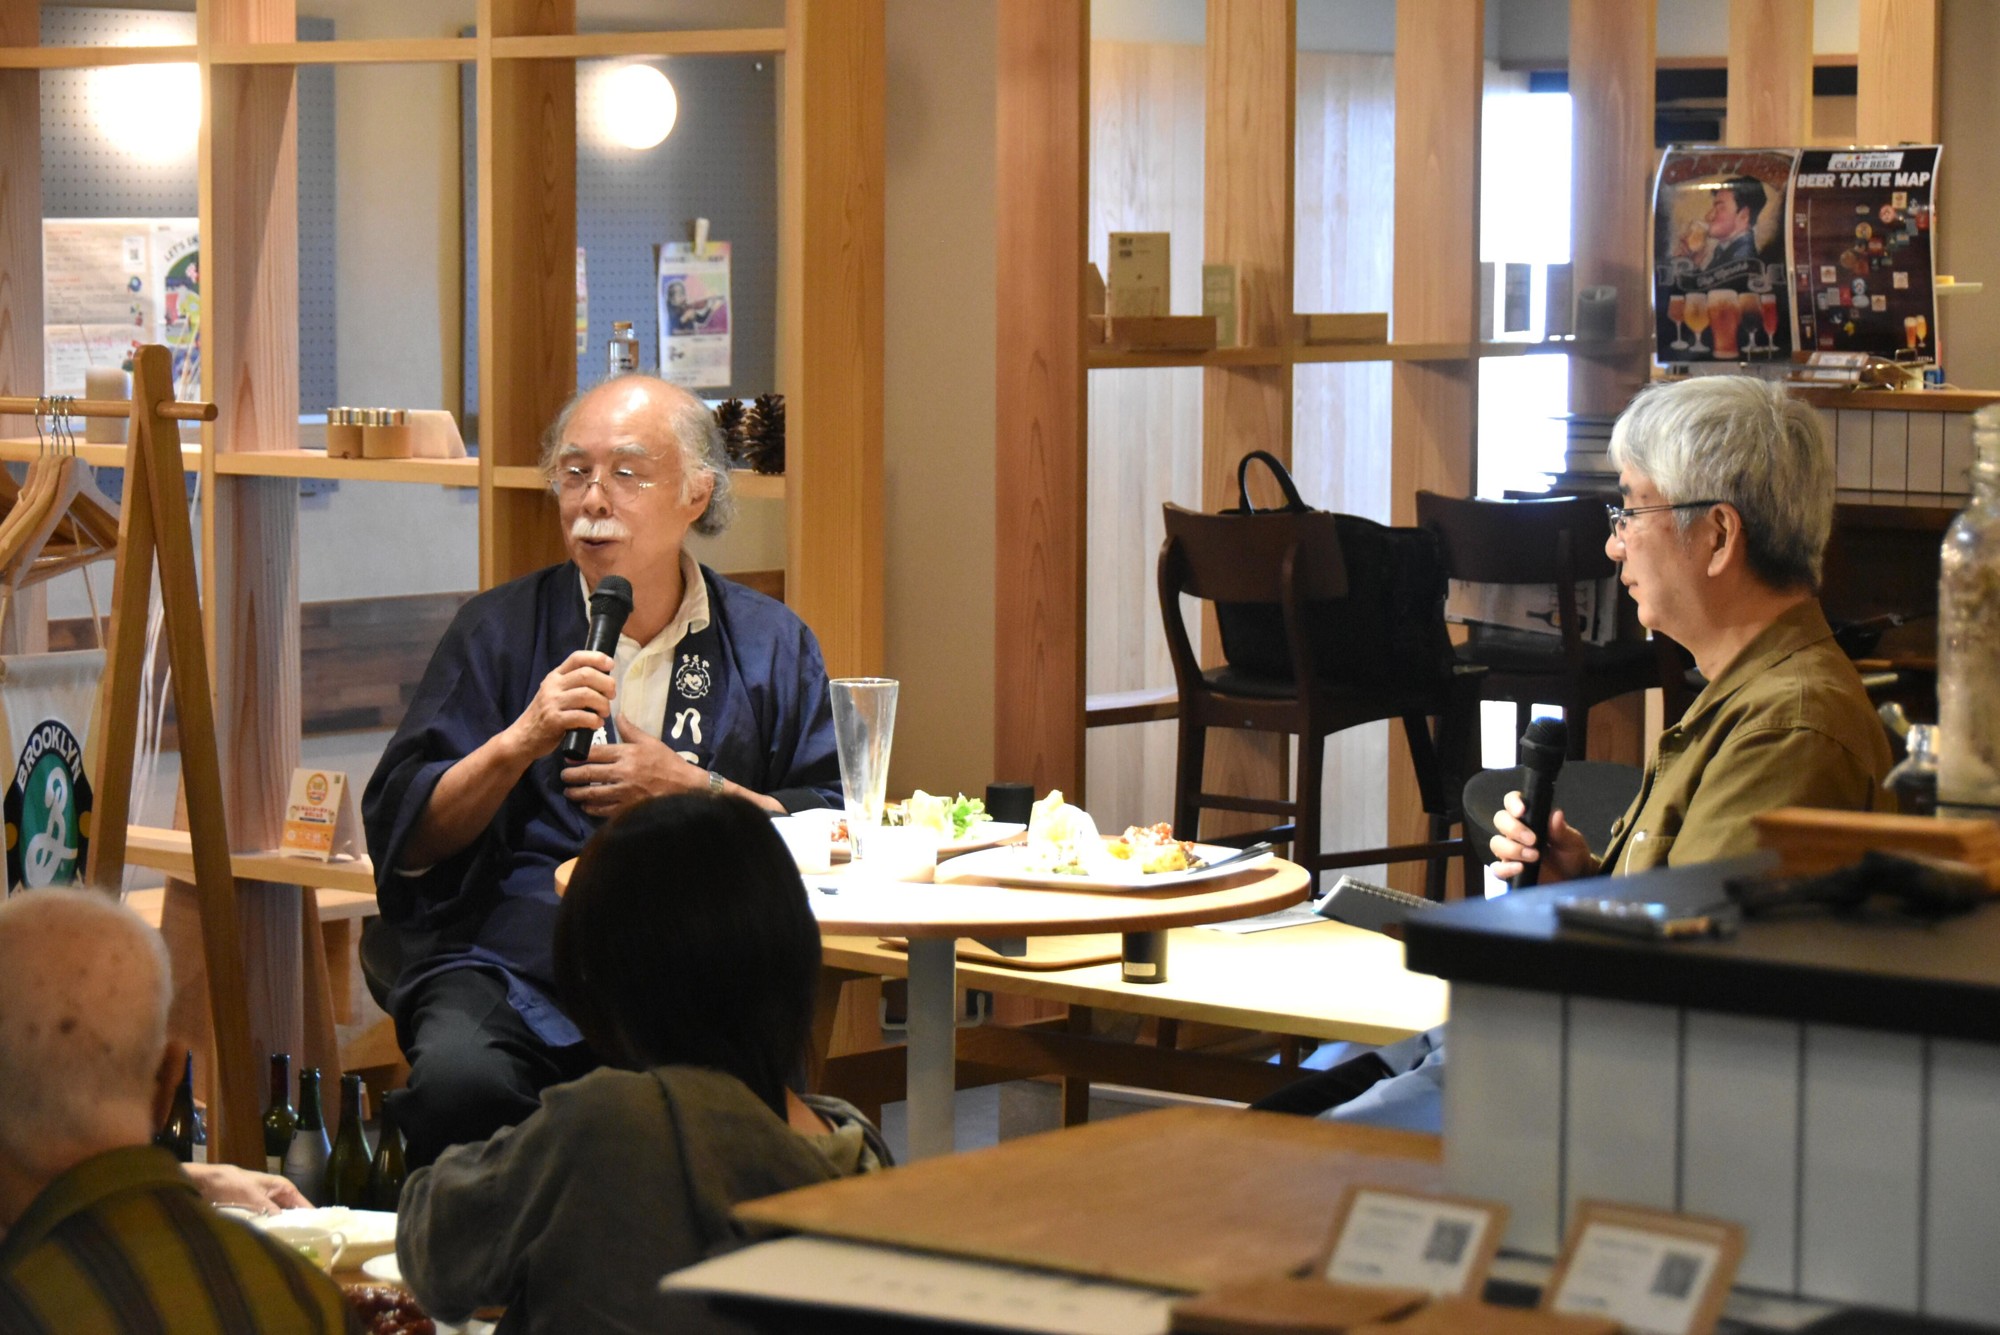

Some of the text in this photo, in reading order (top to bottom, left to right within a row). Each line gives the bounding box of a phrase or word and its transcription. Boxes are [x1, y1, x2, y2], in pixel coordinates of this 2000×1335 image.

[1834, 160, 1896, 169] CRAFT BEER
[1797, 172, 1931, 188] BEER TASTE MAP
[17, 725, 82, 794] BROOKLYN
